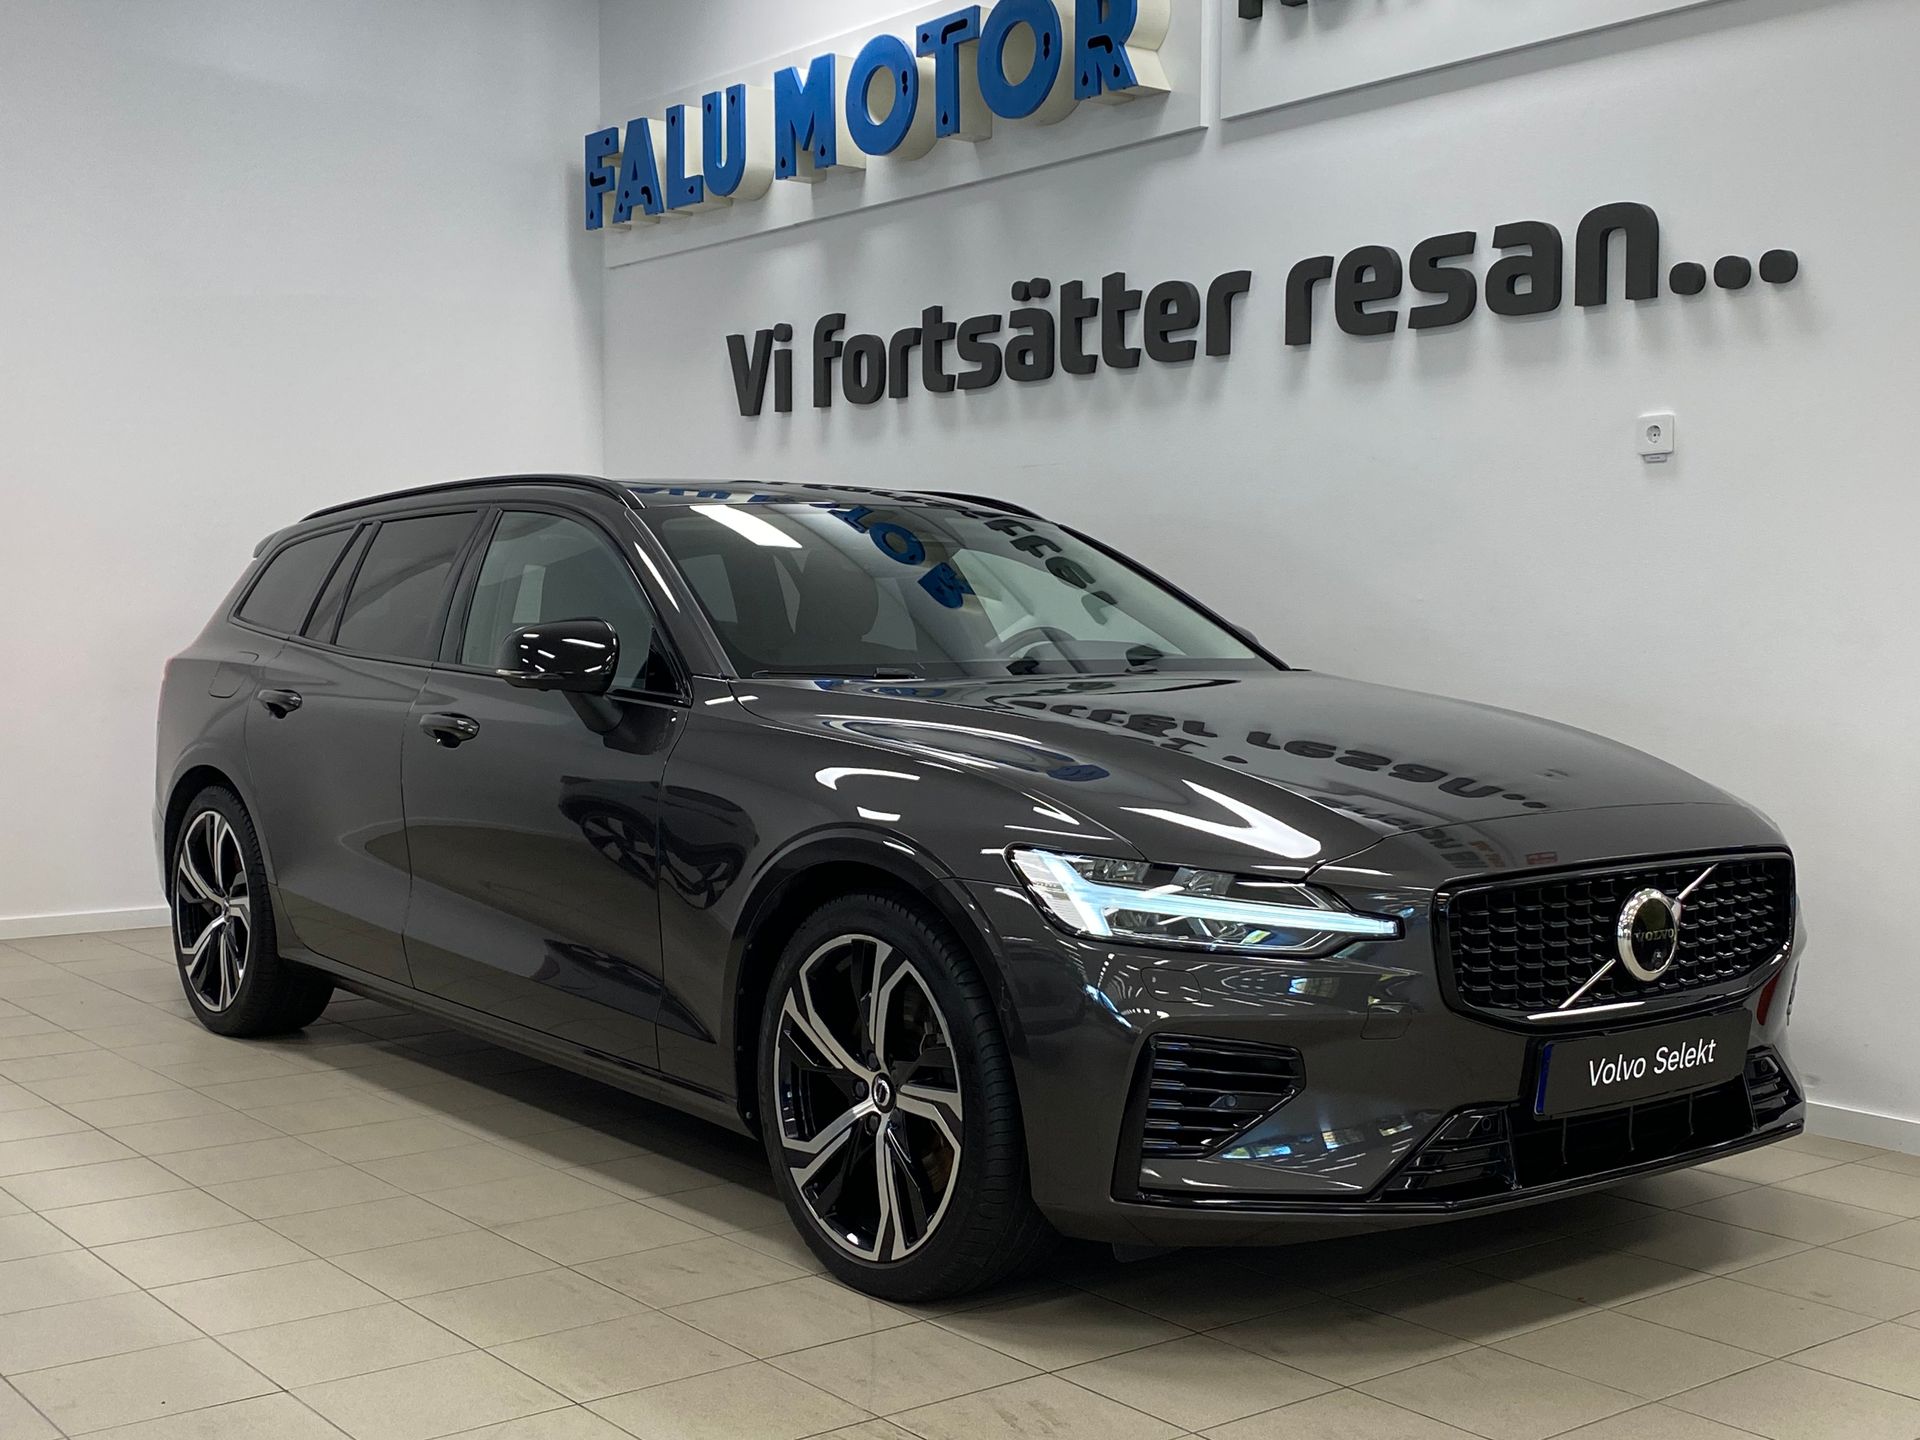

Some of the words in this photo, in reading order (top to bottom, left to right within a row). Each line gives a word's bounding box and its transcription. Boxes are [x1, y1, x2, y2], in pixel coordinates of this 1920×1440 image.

[585, 84, 746, 231] FALU
[774, 0, 1140, 181] MOTOR
[726, 322, 793, 417] Vi
[813, 270, 1252, 408] fortsätter
[1285, 201, 1798, 346] resan...
[1634, 928, 1675, 941] VOLVO
[1589, 1054, 1646, 1087] Volvo
[1653, 1038, 1717, 1074] Selekt
